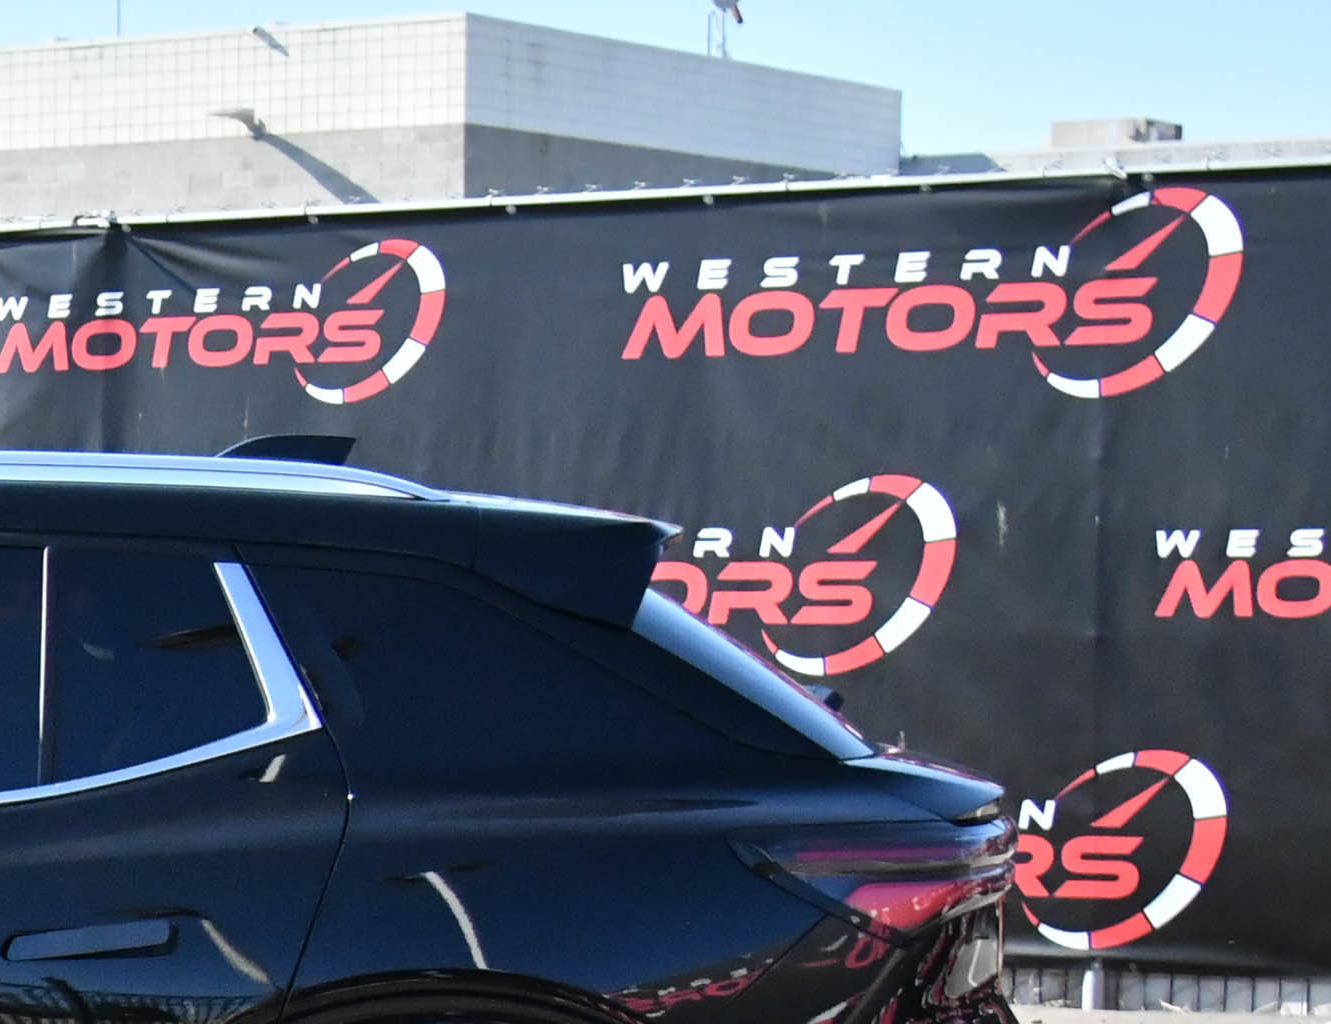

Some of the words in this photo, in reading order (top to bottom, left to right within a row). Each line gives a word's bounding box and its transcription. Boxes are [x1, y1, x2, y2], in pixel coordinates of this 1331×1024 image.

[623, 246, 1070, 293] WESTERN
[622, 277, 1157, 360] MOTORS
[1156, 529, 1324, 557] WES
